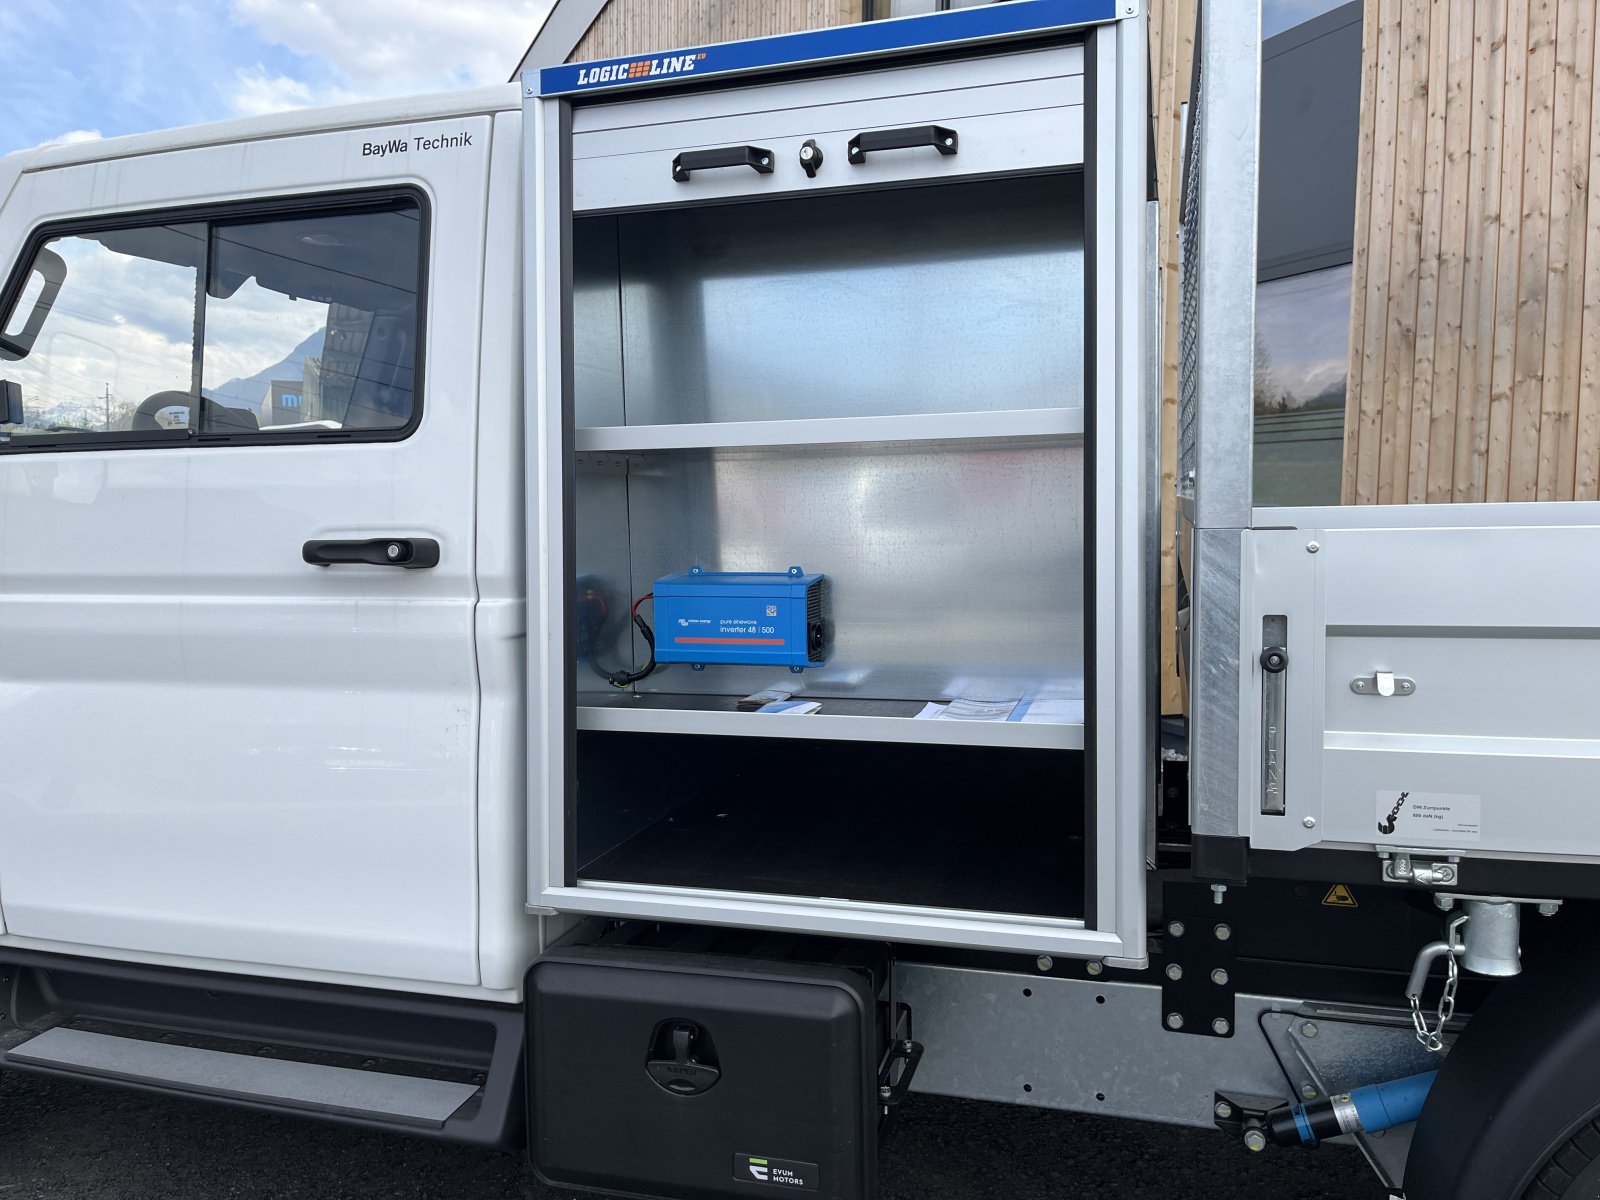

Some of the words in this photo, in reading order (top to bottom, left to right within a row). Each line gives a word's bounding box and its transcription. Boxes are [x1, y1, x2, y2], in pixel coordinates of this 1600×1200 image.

[577, 63, 629, 85] LOGIC
[649, 54, 697, 76] LINE
[362, 139, 408, 157] BayWa
[414, 132, 473, 151] Technik
[747, 626, 757, 634] 48
[761, 626, 775, 634] 500
[772, 1168, 793, 1177] EVUM
[772, 1175, 804, 1186] MOTORS
